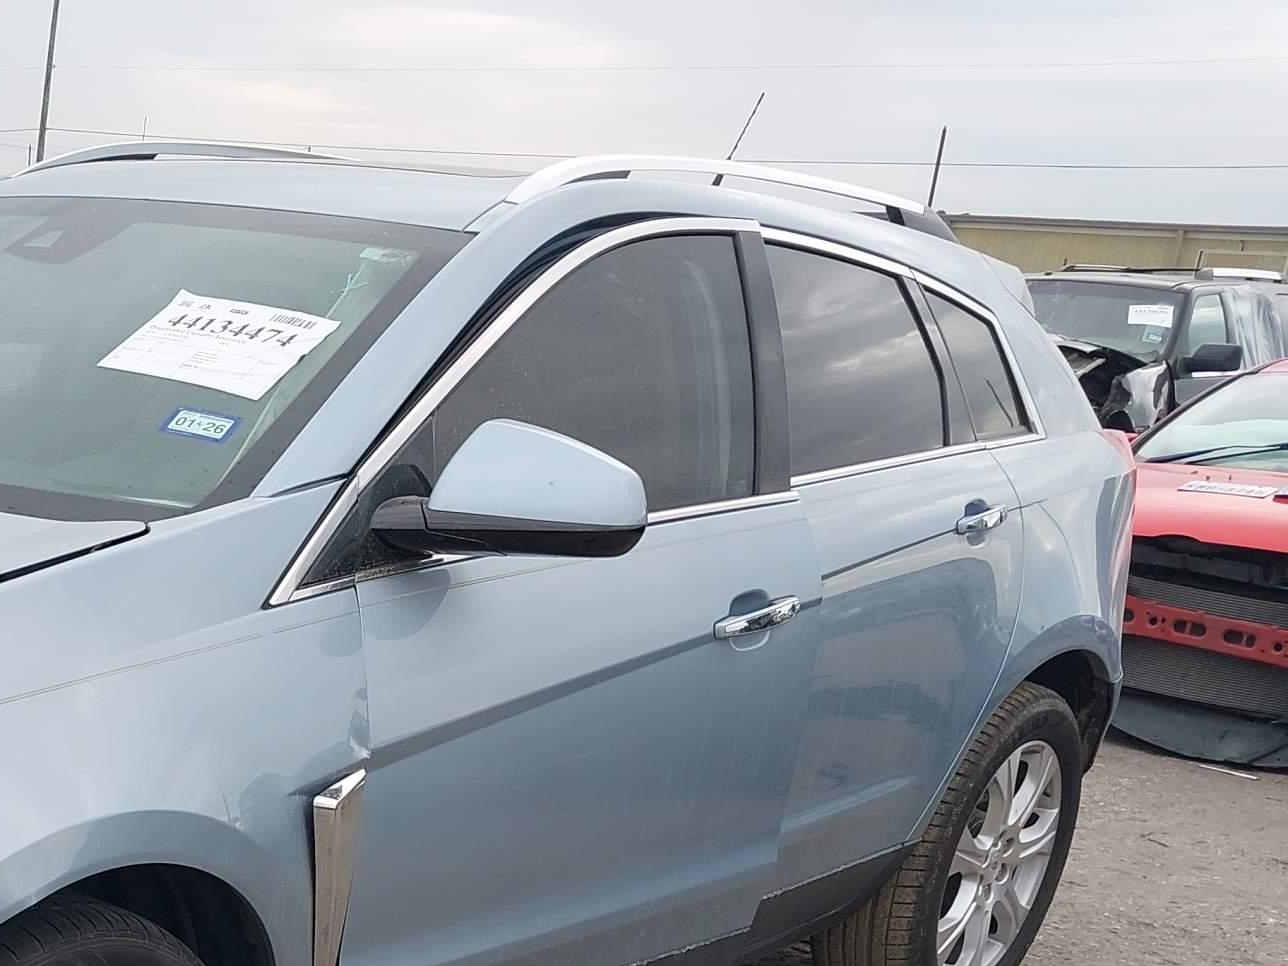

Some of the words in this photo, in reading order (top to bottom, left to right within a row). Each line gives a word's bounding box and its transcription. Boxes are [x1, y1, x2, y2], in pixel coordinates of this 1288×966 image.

[168, 314, 298, 347] 44134474
[175, 416, 196, 428] 01
[202, 422, 226, 434] 26
